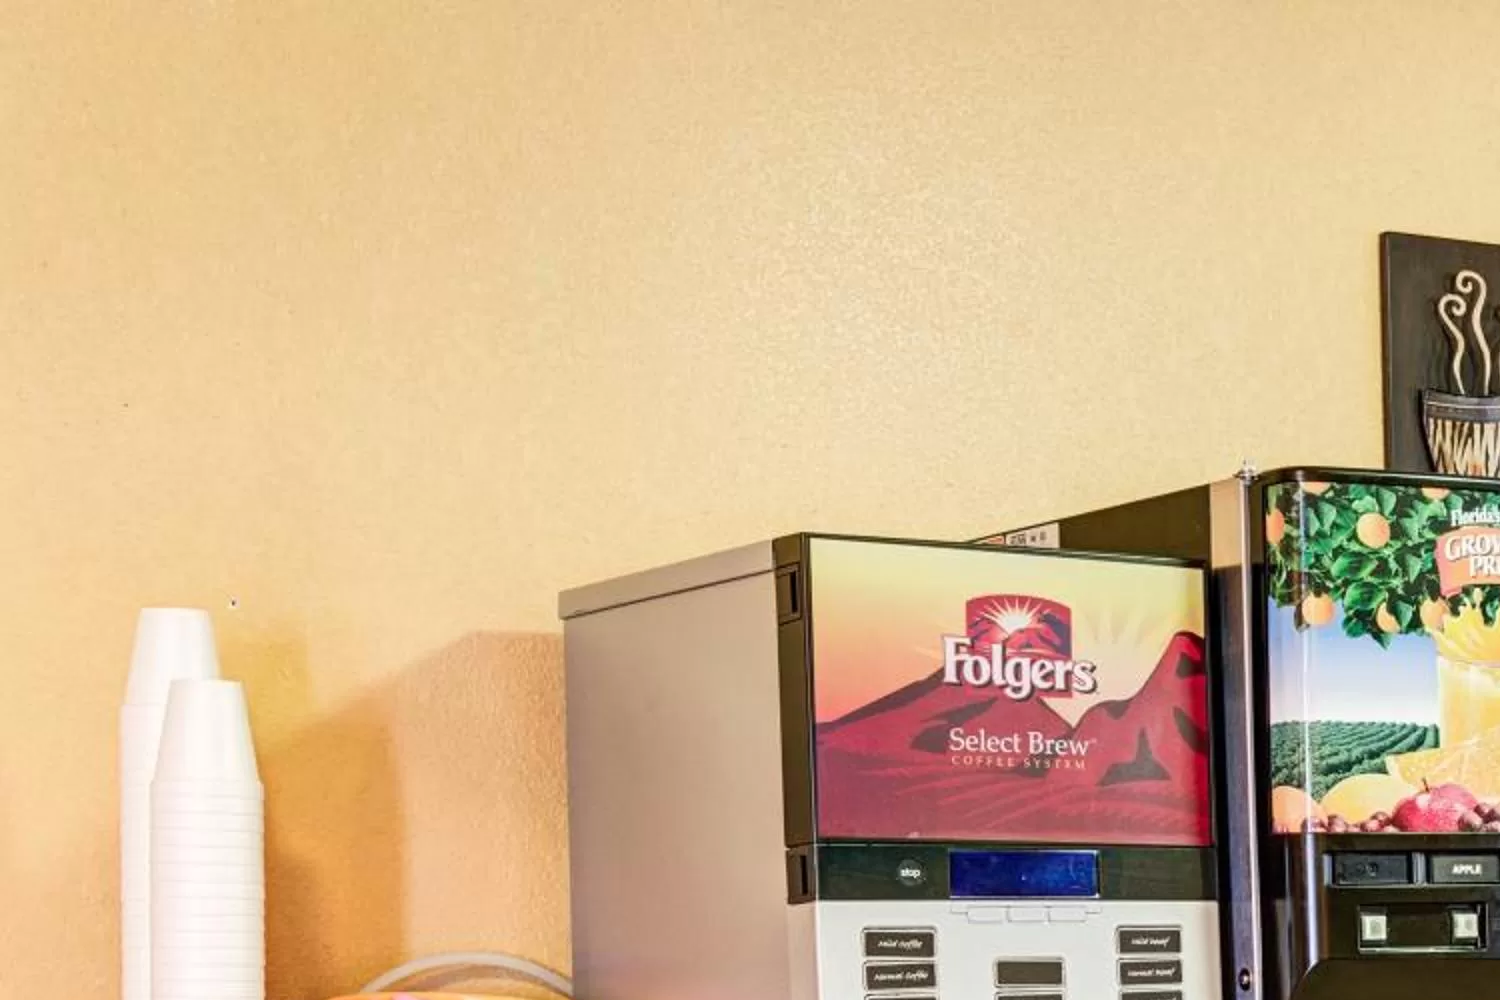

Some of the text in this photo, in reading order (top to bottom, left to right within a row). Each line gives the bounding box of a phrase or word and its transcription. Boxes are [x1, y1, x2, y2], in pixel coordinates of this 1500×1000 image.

[943, 635, 1097, 700] Folgers
[949, 728, 1088, 756] Select Brew
[951, 755, 1086, 769] COFFEE SYSTEM
[900, 868, 920, 879] stop
[1452, 863, 1483, 875] APPLE
